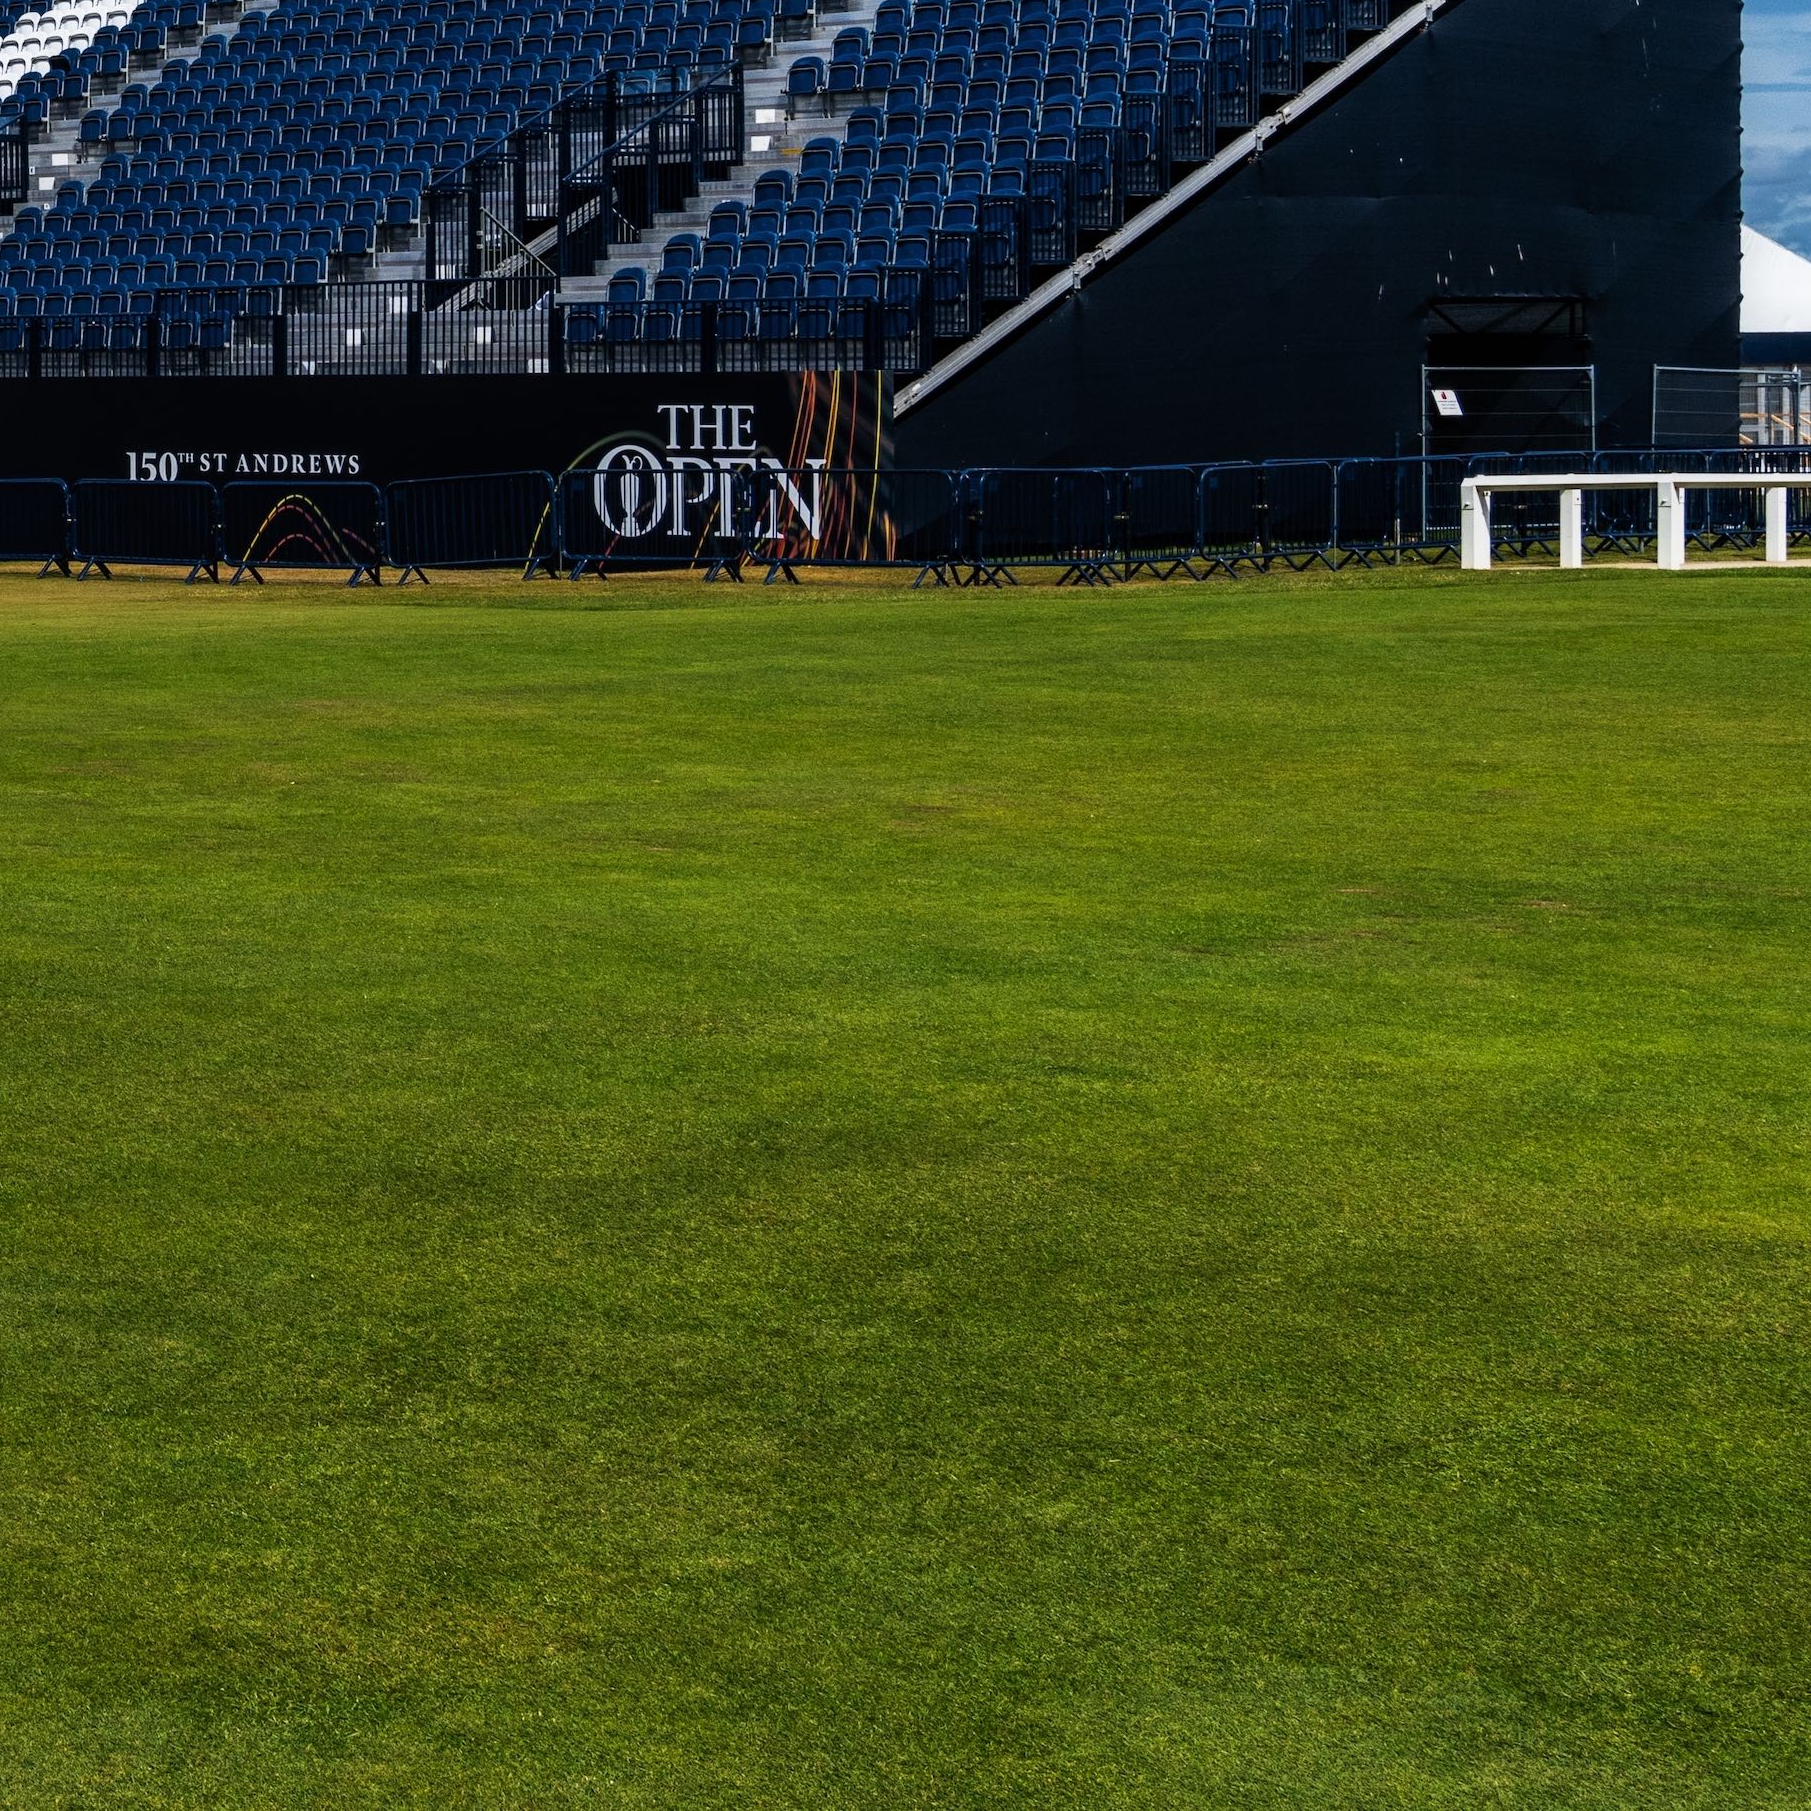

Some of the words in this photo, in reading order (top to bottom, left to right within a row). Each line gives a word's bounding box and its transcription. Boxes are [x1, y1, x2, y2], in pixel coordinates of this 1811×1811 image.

[657, 404, 757, 450] THE
[199, 453, 227, 472] ST
[235, 453, 360, 474] ANDREWS
[593, 444, 827, 540] OPEN
